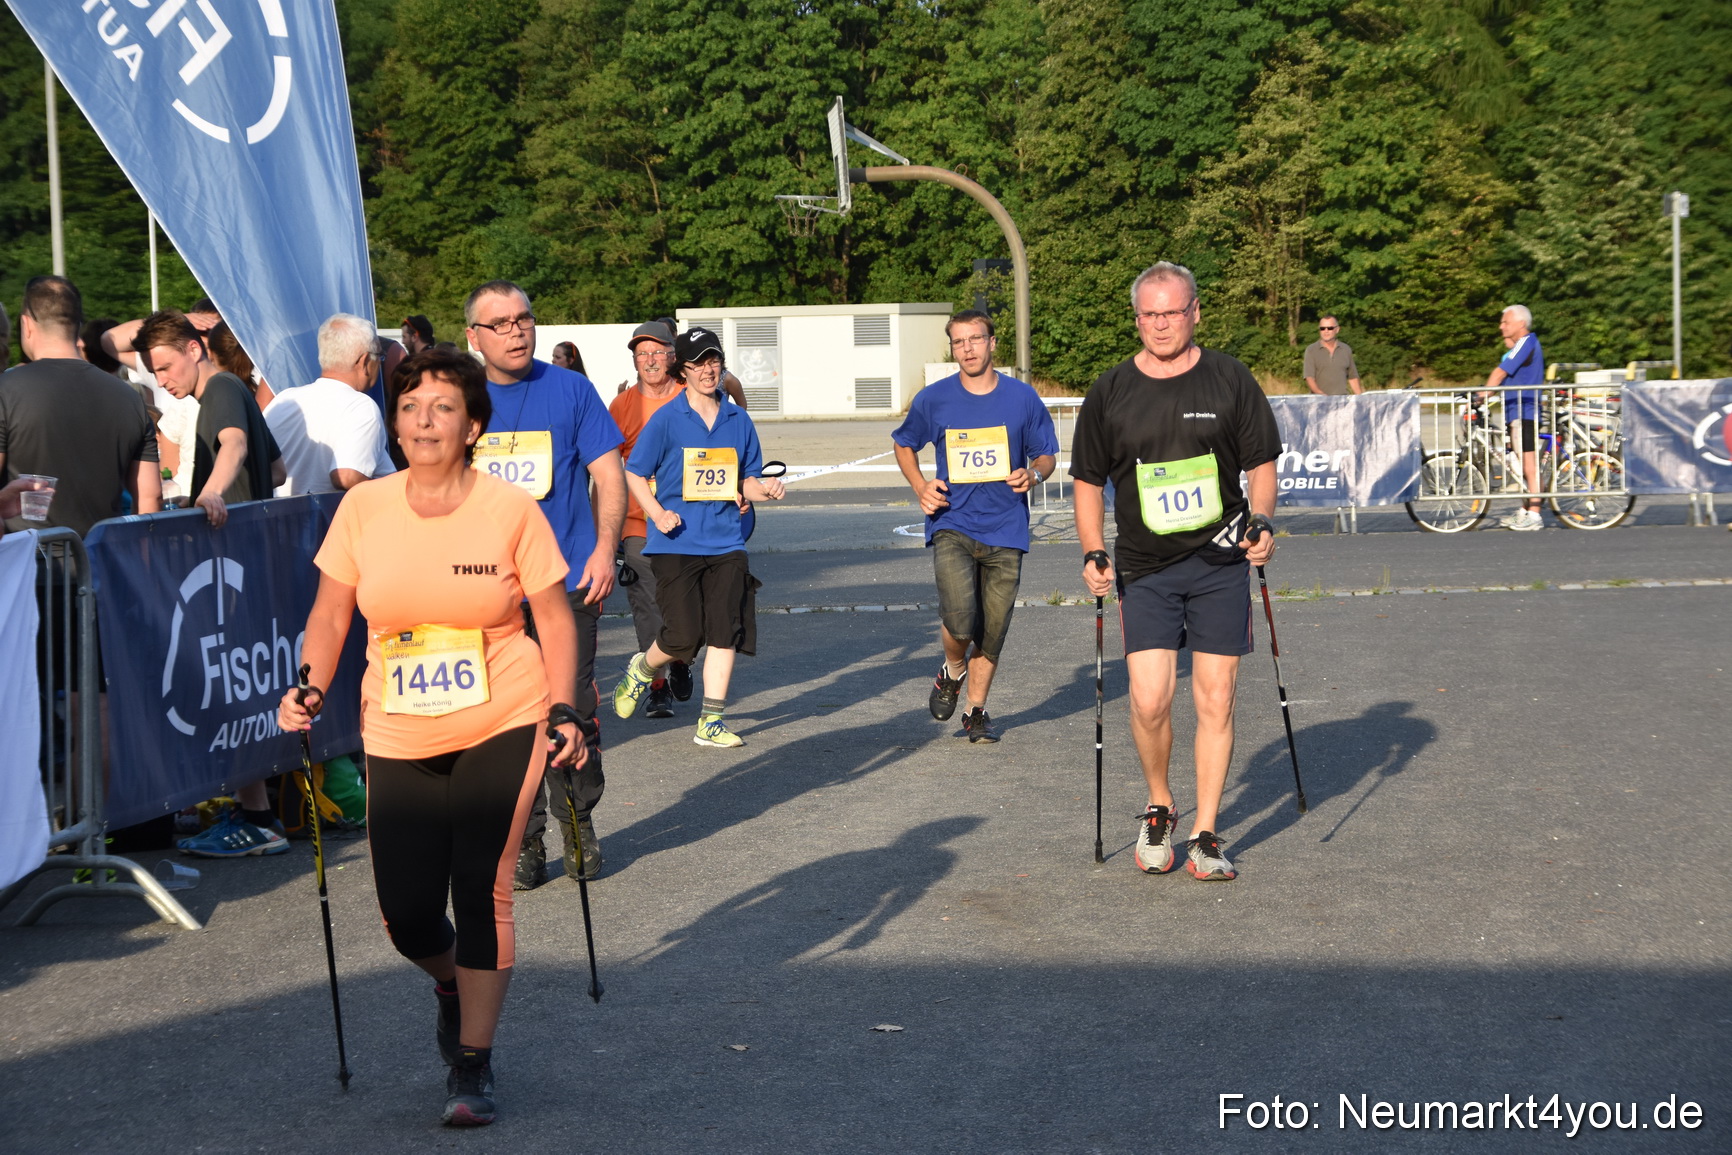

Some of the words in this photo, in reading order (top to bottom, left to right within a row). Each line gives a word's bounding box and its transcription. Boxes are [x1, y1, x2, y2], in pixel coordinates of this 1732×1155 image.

[959, 449, 997, 468] 765
[1276, 443, 1351, 473] her
[487, 461, 536, 483] 802
[695, 469, 726, 486] 793
[1276, 477, 1338, 490] OBILE
[1157, 486, 1204, 514] 101
[451, 564, 498, 576] THULE
[392, 659, 475, 696] 1446
